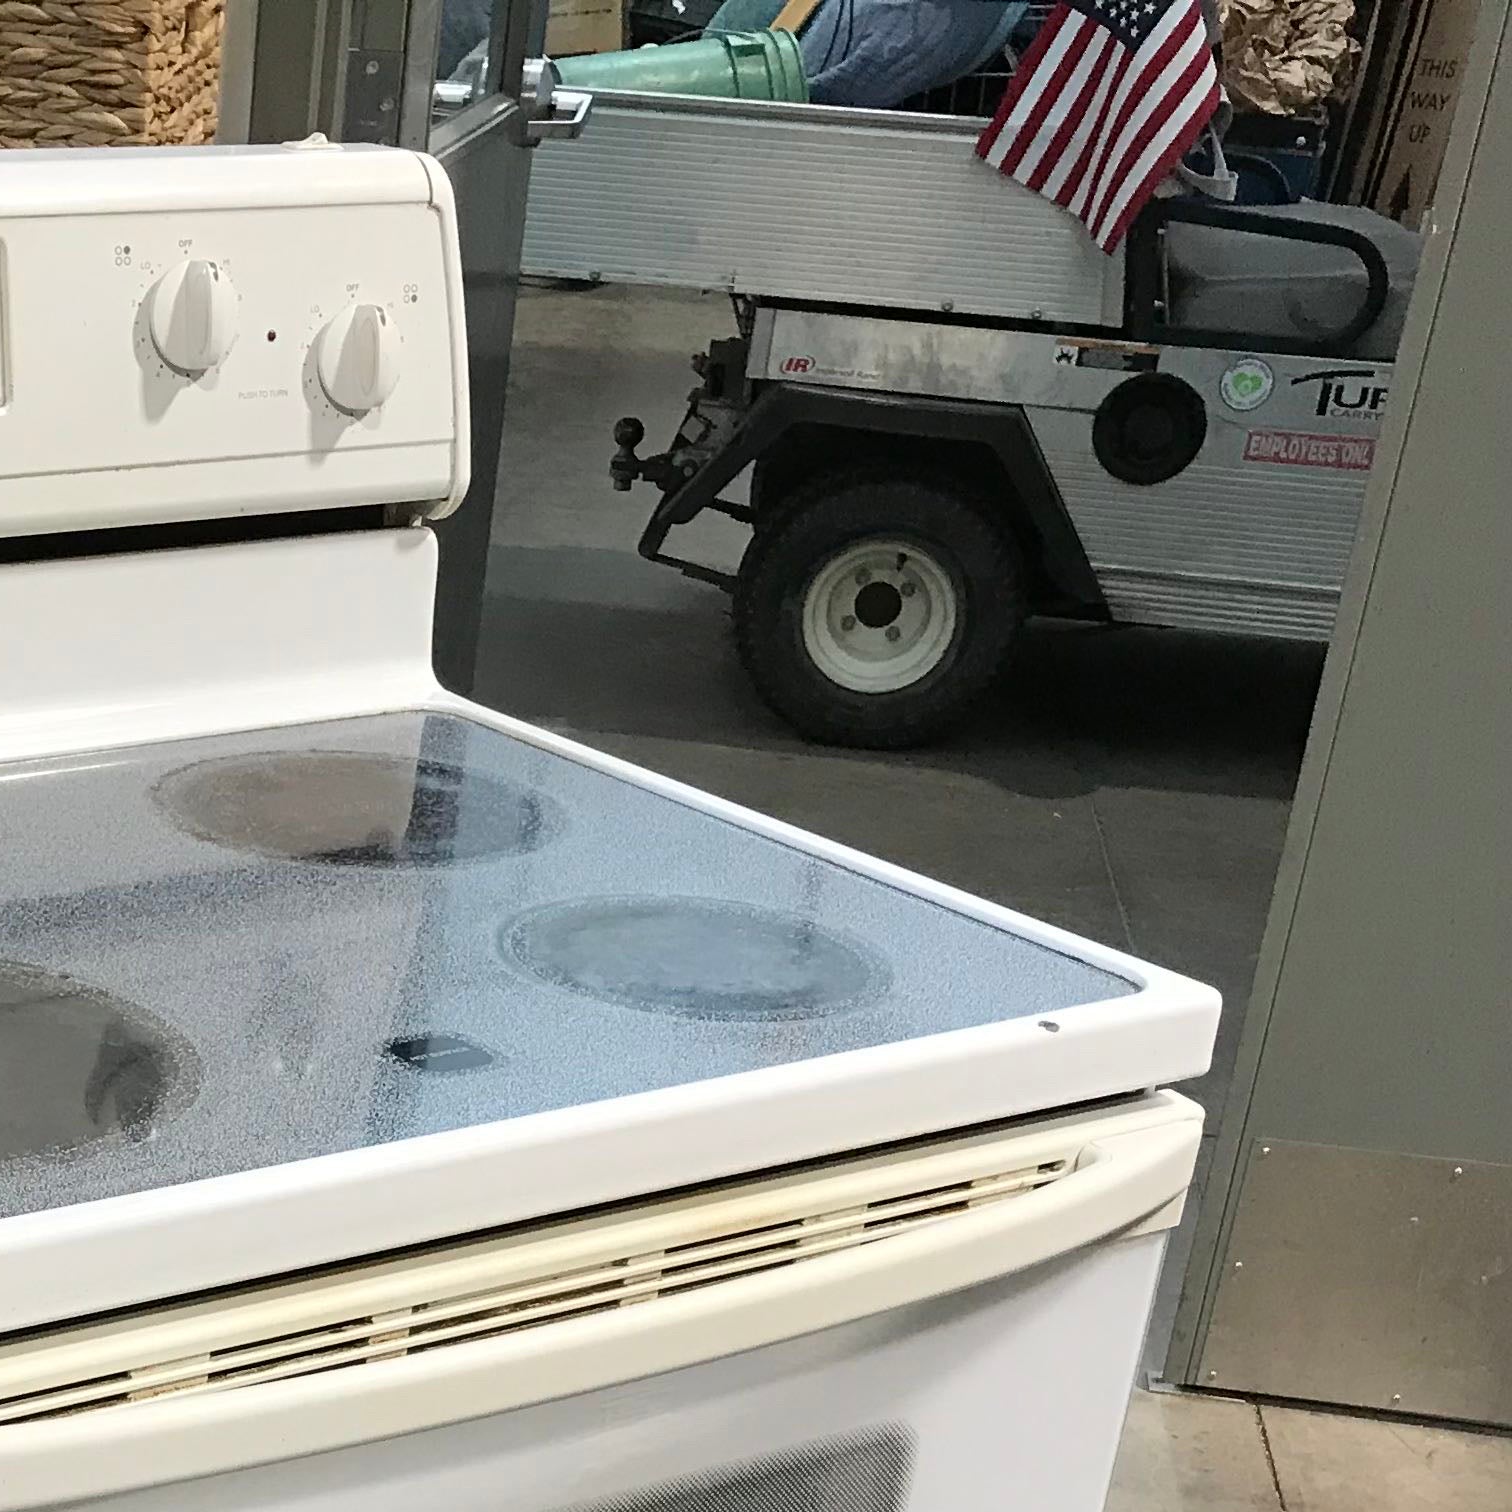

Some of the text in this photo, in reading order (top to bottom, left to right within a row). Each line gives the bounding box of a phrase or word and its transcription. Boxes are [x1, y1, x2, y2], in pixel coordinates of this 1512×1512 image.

[1420, 58, 1458, 79] THIS
[1410, 91, 1451, 111] WAY
[1409, 124, 1431, 143] UP
[178, 240, 193, 248] OFF
[140, 262, 151, 270] LO
[346, 284, 359, 292] OFF
[785, 358, 809, 372] IR
[1249, 435, 1337, 462] EMPLOYEES
